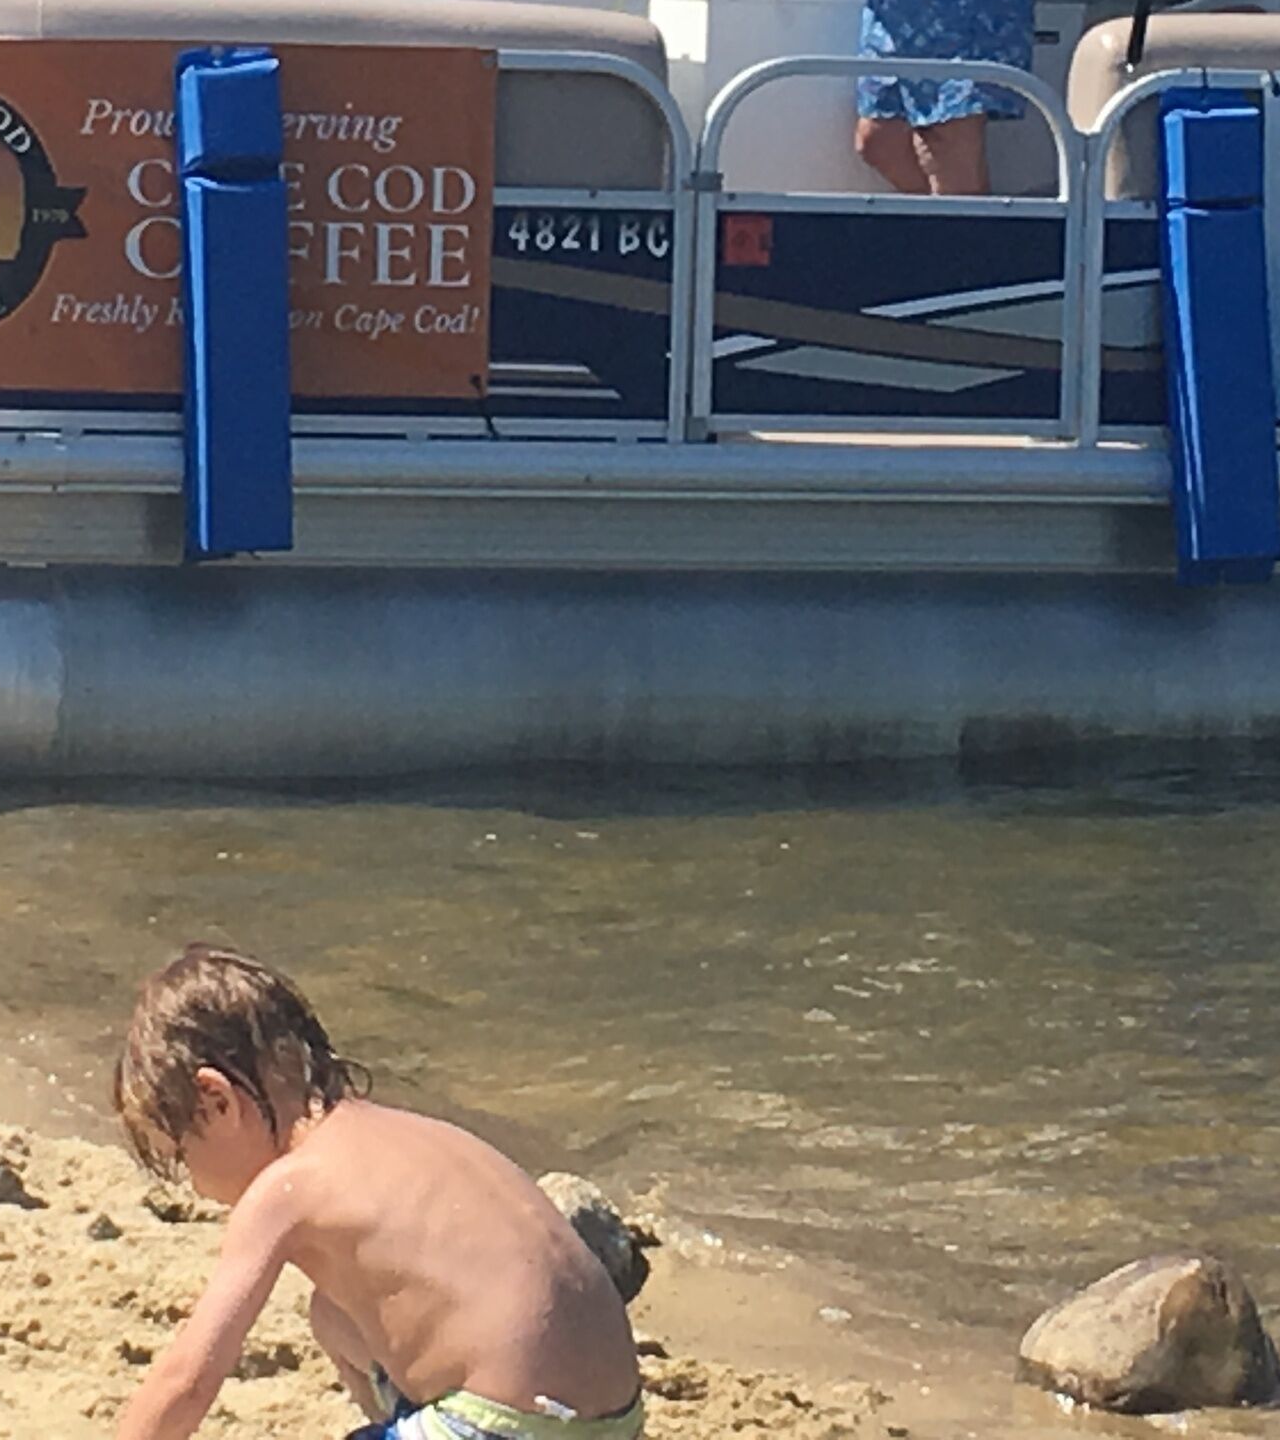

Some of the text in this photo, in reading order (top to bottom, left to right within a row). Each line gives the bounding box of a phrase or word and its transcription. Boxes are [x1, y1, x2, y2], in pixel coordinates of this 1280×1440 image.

[80, 98, 404, 154] Prou erving
[126, 158, 477, 215] CE COD
[508, 212, 601, 252] 4821
[51, 293, 159, 333] Freshly
[334, 303, 406, 341] Cape
[414, 303, 481, 335] Cod!
